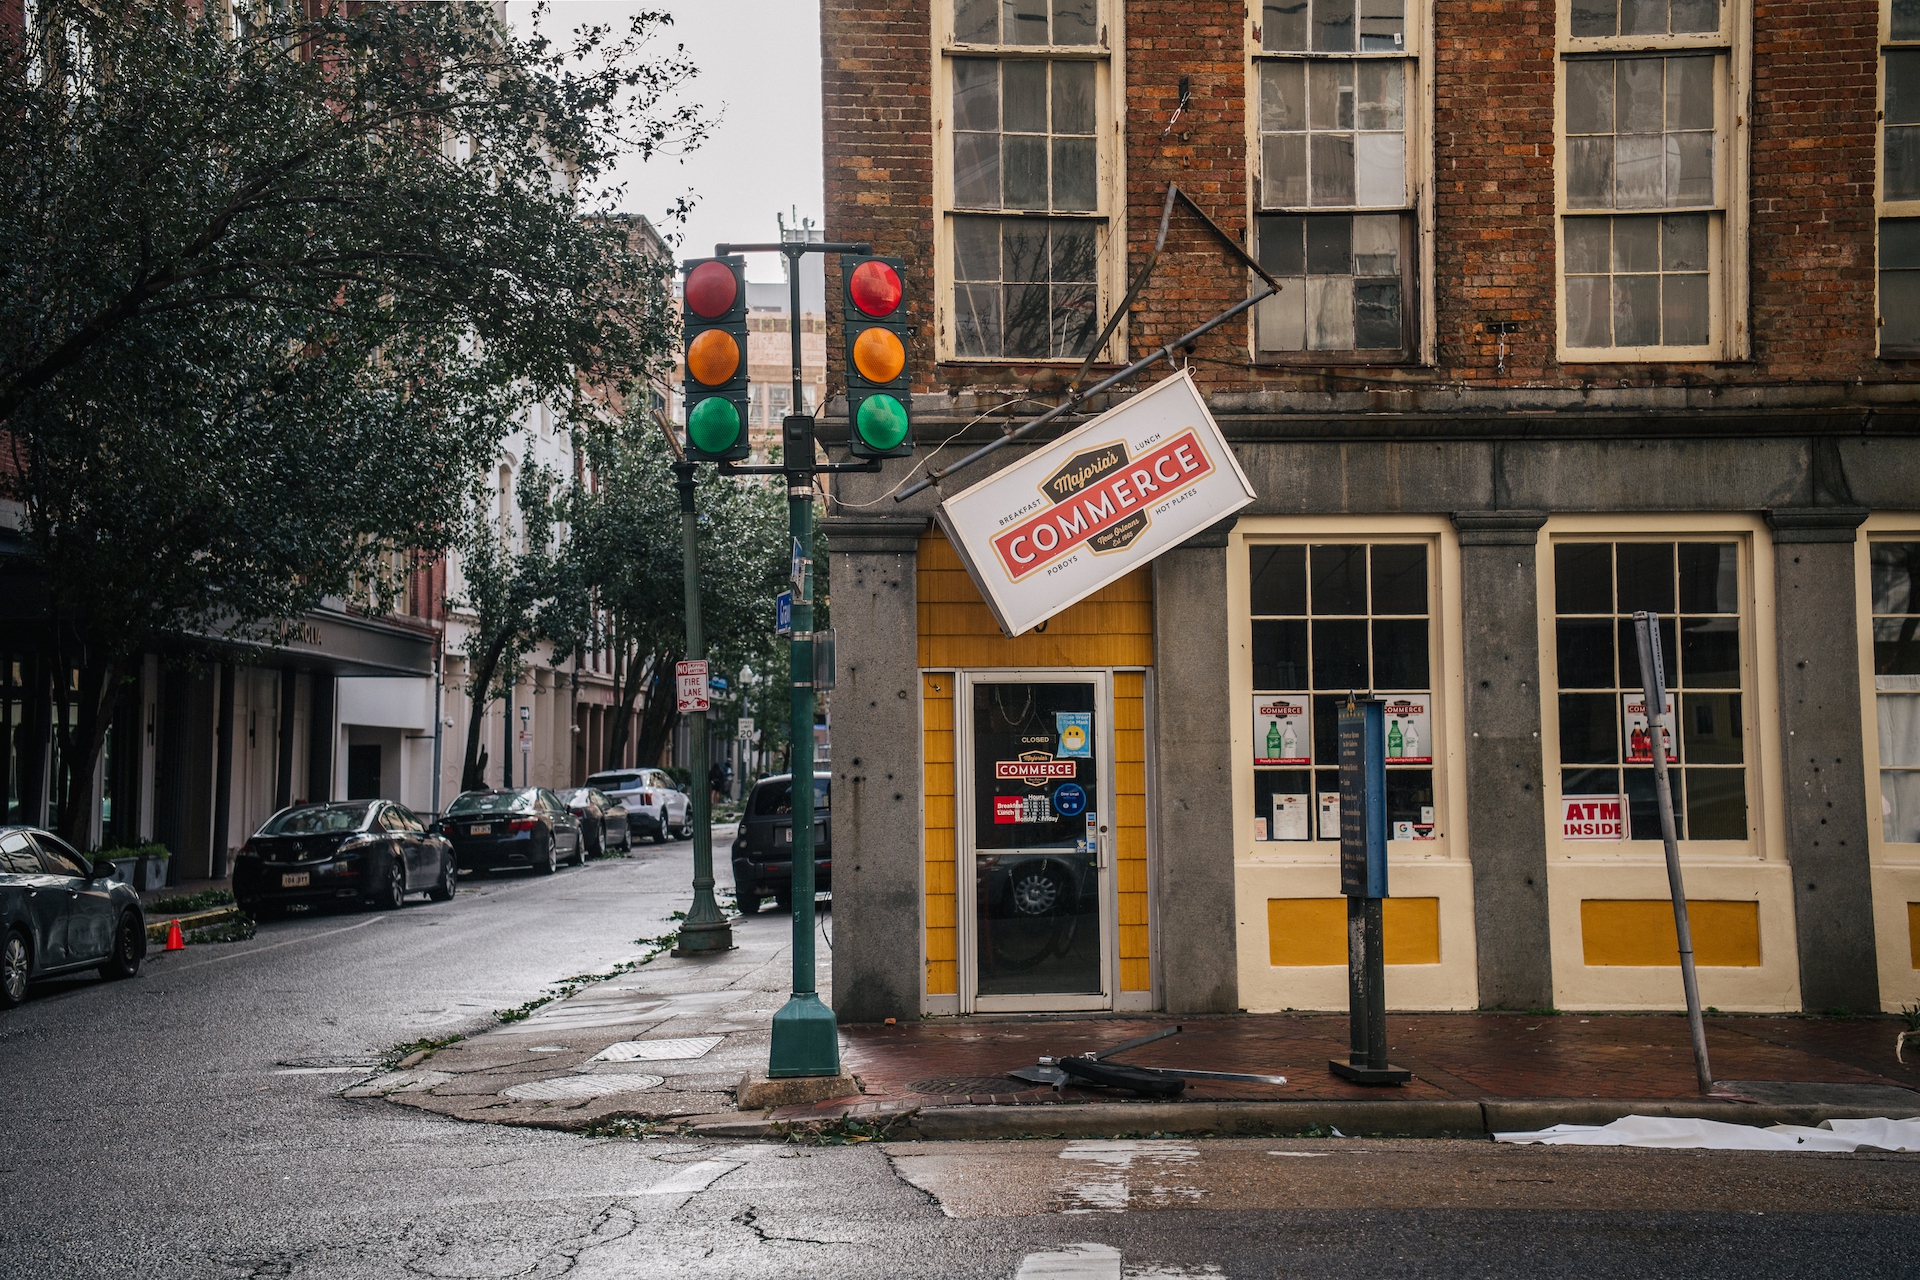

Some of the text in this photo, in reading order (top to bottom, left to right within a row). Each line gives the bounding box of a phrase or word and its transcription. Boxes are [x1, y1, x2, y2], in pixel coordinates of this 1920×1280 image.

[1134, 432, 1162, 451] LUNCH
[1053, 451, 1119, 494] Majoria's
[1009, 443, 1201, 564] COMMERCE
[1155, 488, 1198, 516] HOT PLATES
[998, 498, 1042, 526] BREAKFAST
[1097, 518, 1140, 545] New Orleans
[1047, 555, 1078, 576] POBOYS
[678, 664, 688, 674] NO
[684, 678, 700, 686] FIRE
[684, 688, 702, 697] LANE
[740, 729, 753, 738] 20
[1000, 765, 1072, 775] COMMERCE
[1566, 803, 1621, 820] ATM
[1564, 823, 1621, 835] INSIDE
